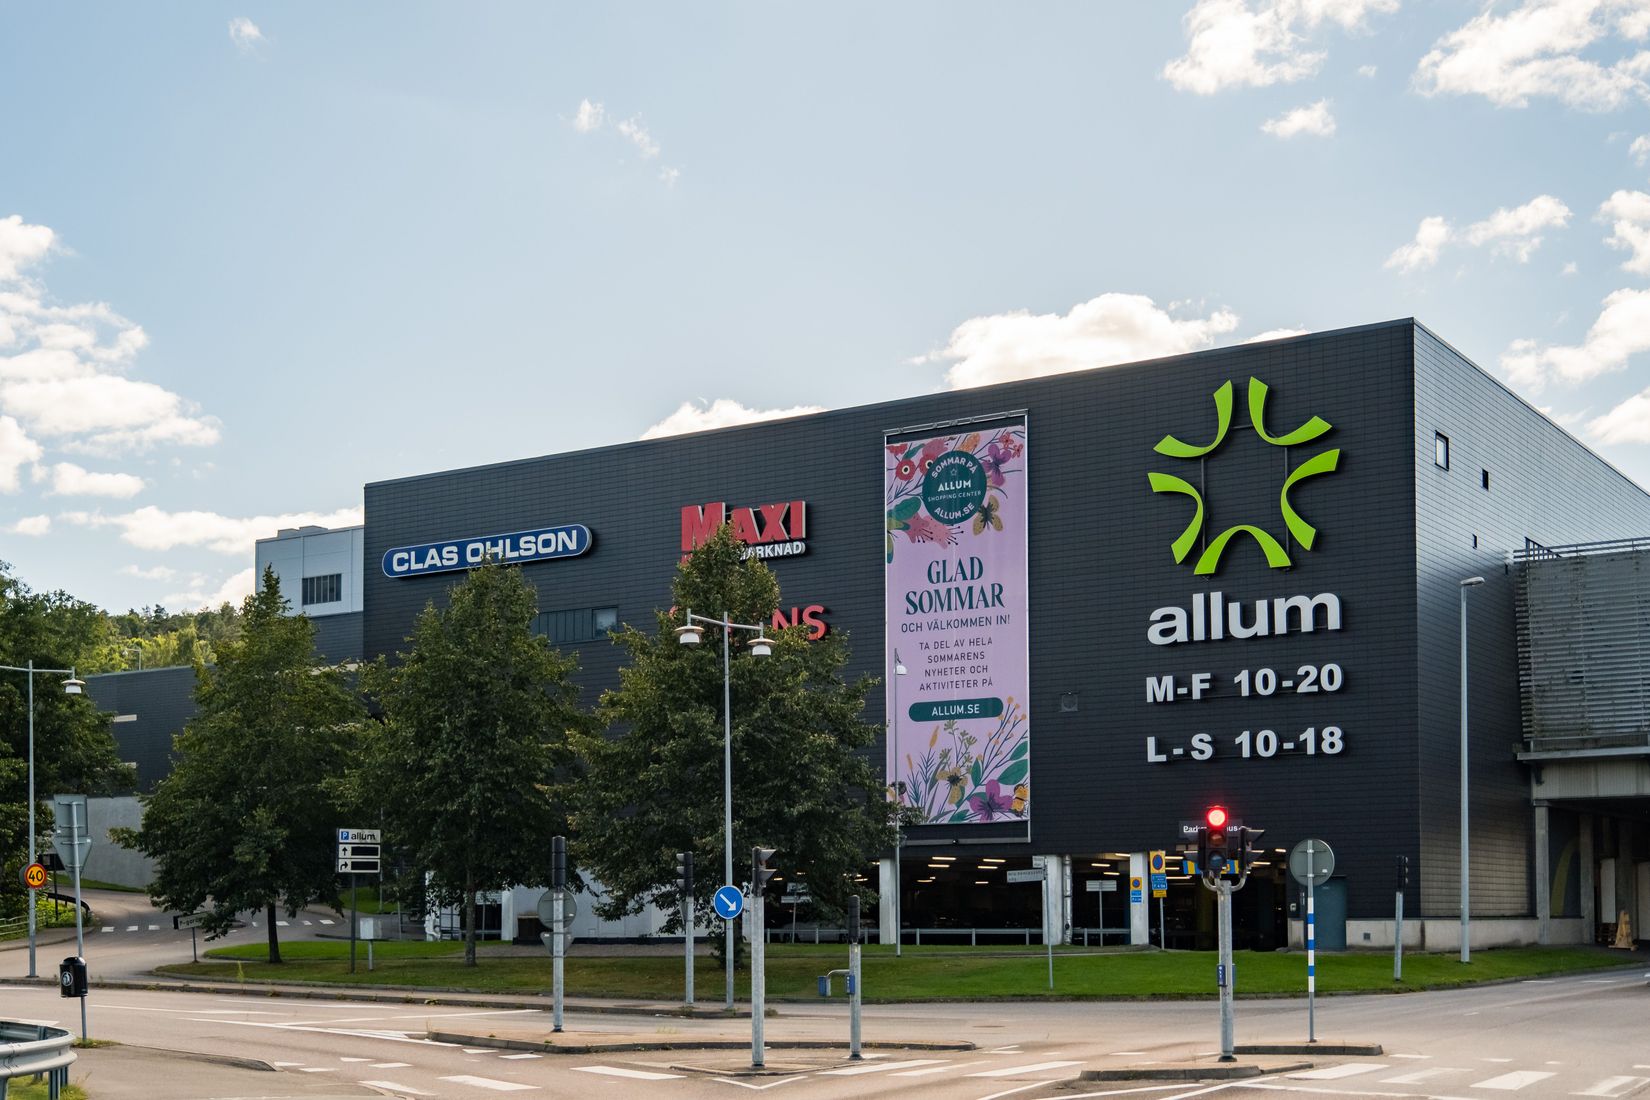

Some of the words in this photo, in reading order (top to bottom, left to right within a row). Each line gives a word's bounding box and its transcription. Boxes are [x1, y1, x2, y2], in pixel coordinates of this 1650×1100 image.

[931, 457, 966, 478] SOMMAR
[966, 461, 978, 474] PÅ
[937, 480, 972, 492] ALLUM
[928, 493, 957, 502] SHOPPING
[958, 490, 981, 498] CENTER
[934, 502, 975, 519] ALLUM.SE
[681, 501, 805, 552] MAXI
[392, 546, 458, 572] CLAS
[466, 530, 577, 563] OHLSON
[927, 556, 983, 584] GLAD
[905, 583, 1005, 615] SOMMAR
[901, 622, 923, 633] OCH
[927, 616, 992, 631] VÄLKOMMEN
[996, 614, 1010, 625] IN!
[1147, 591, 1340, 645] allum
[920, 642, 930, 651] TA
[934, 640, 950, 650] DEL
[954, 639, 965, 648] AV
[969, 637, 993, 647] HELA
[927, 651, 985, 664] SOMMARENS
[925, 666, 966, 677] NYHETER
[970, 665, 988, 674] OCH
[920, 679, 978, 692] AKTIVITETER
[982, 677, 993, 687] PÅ
[1146, 673, 1211, 702] M-F
[1234, 663, 1342, 697] 10-20
[932, 704, 980, 717] ALLUM.SE
[1147, 733, 1213, 762] L-S
[1235, 726, 1344, 758] 10-18
[351, 832, 376, 840] allum
[29, 870, 44, 882] 40
